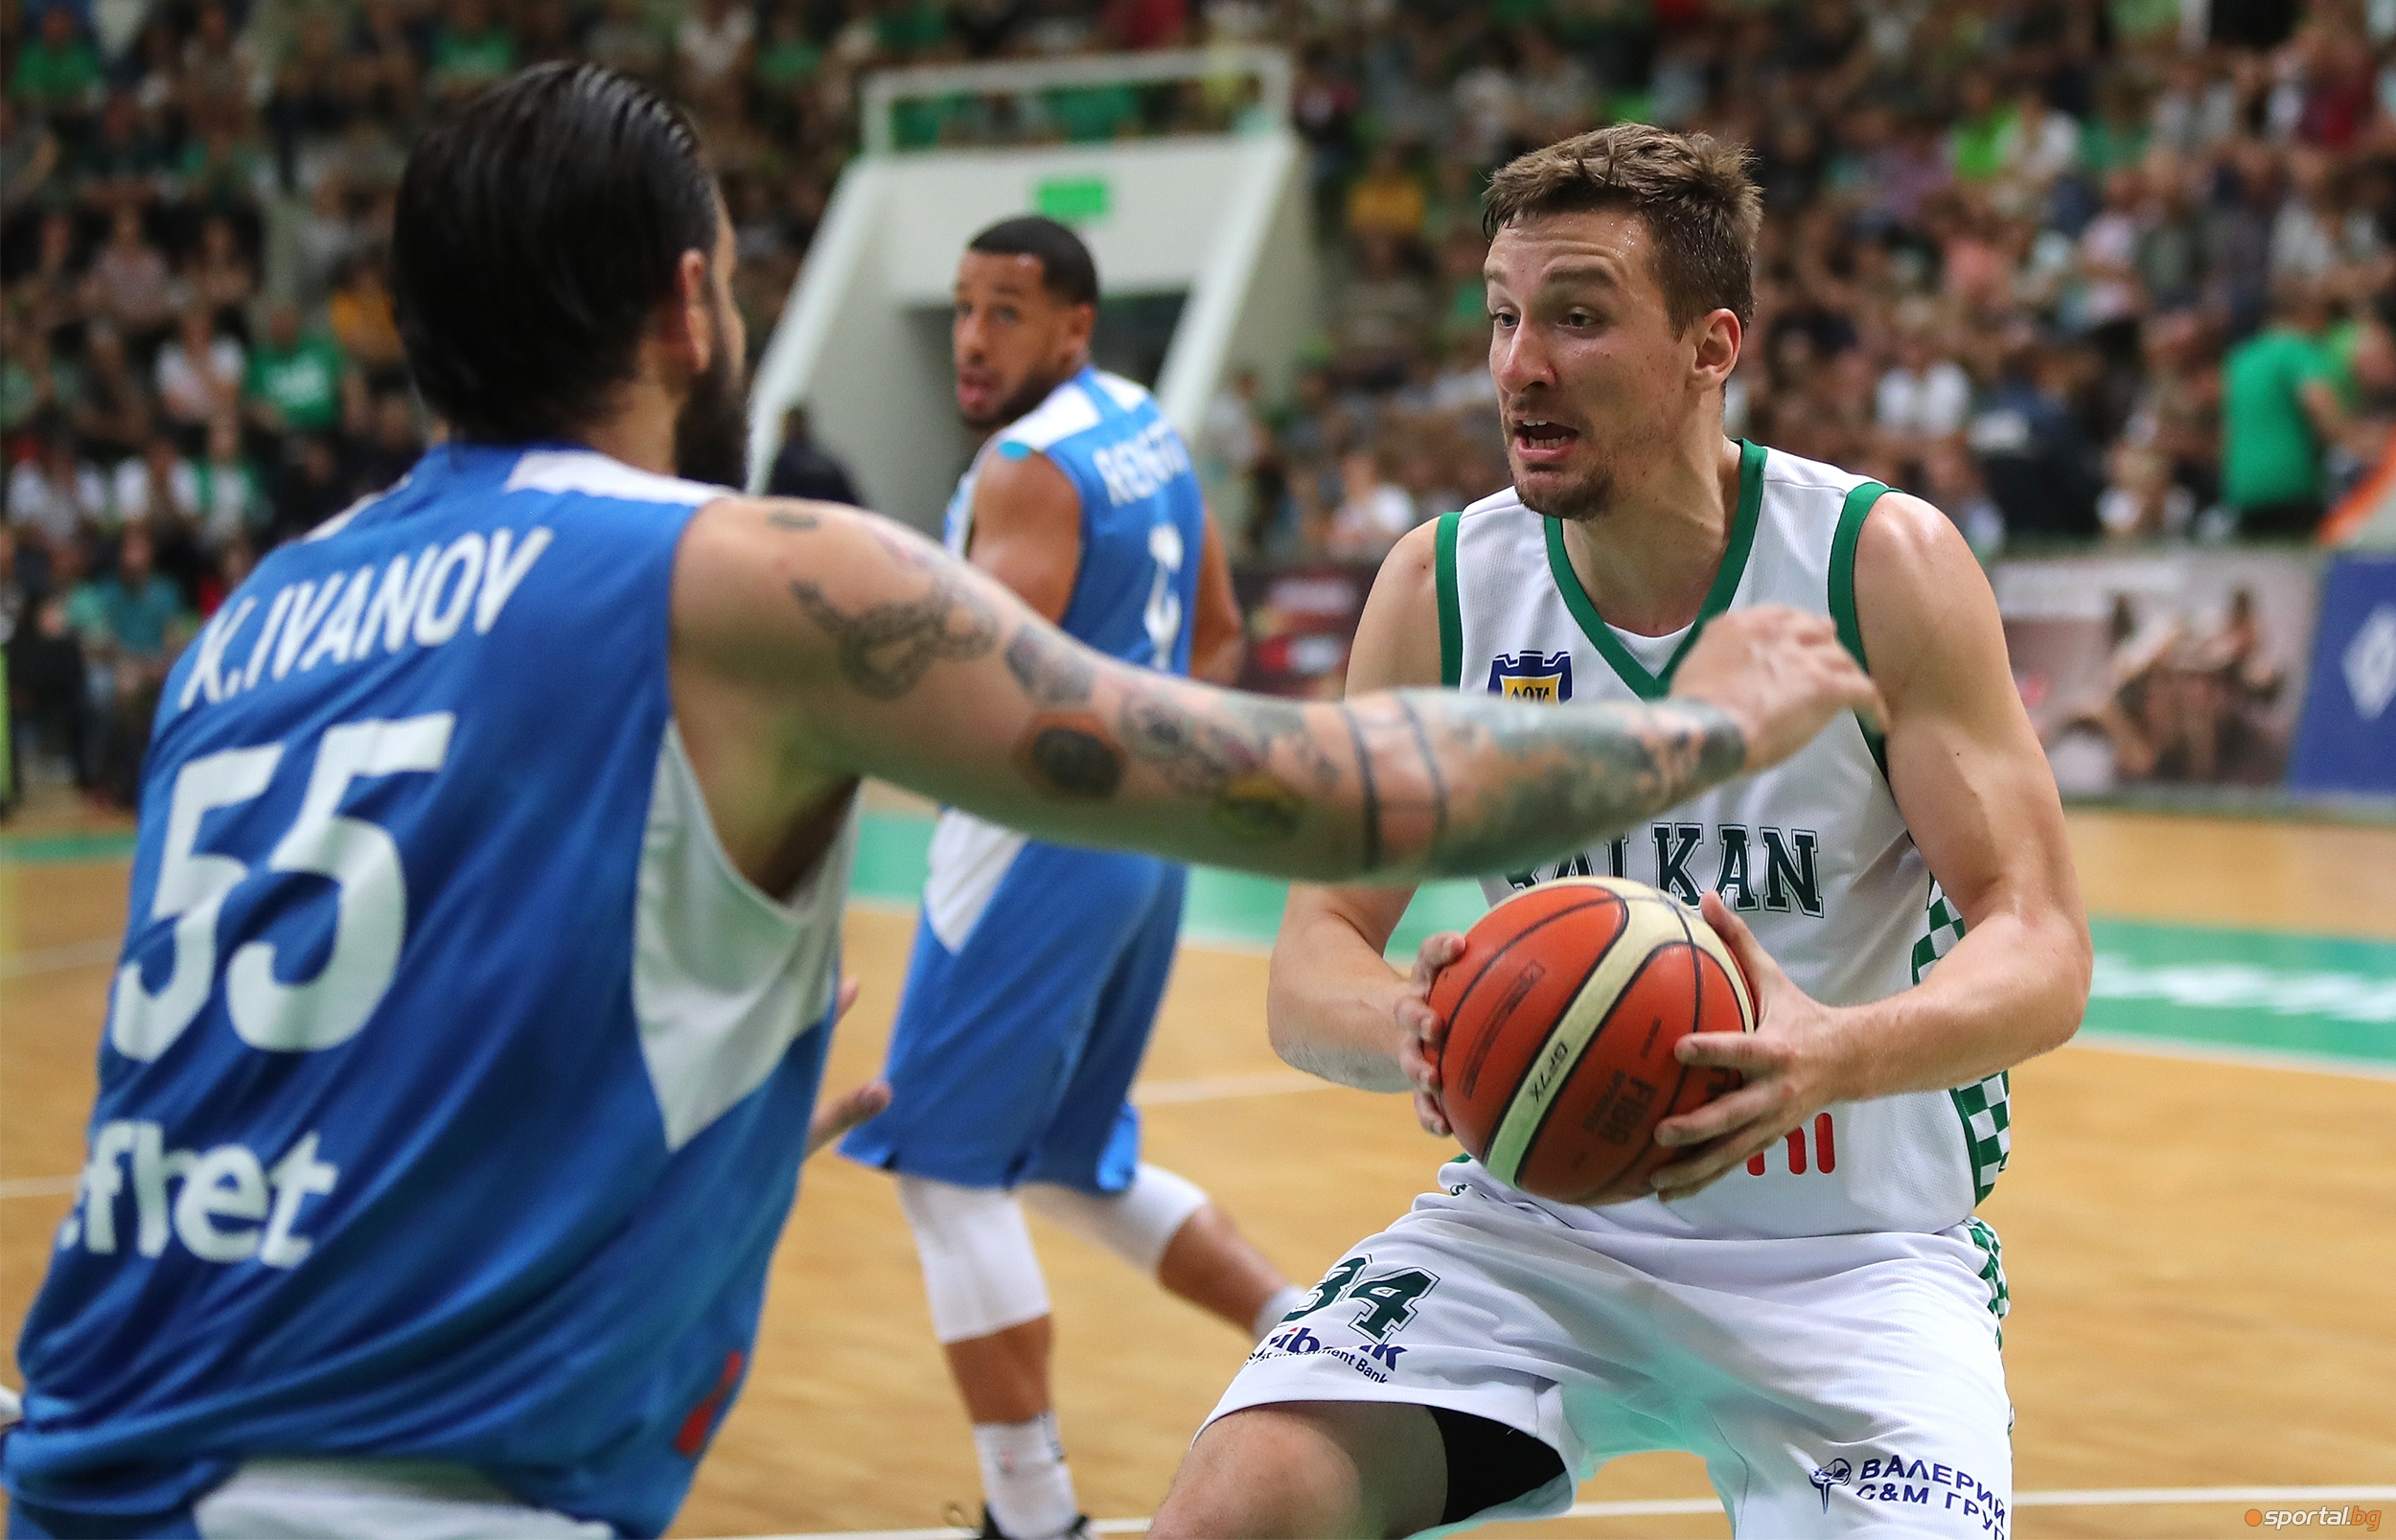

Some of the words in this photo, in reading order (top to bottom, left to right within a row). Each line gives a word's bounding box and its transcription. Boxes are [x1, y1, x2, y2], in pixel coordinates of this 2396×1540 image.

[179, 527, 554, 711] K.IVANOV
[110, 711, 457, 1063] 55
[1507, 822, 1824, 919] KAN
[58, 1118, 338, 1271] fet
[1276, 1253, 1441, 1345] 34
[1354, 1357, 1389, 1385] Bank
[1859, 1454, 2006, 1529] ВАЛЕРИЙ
